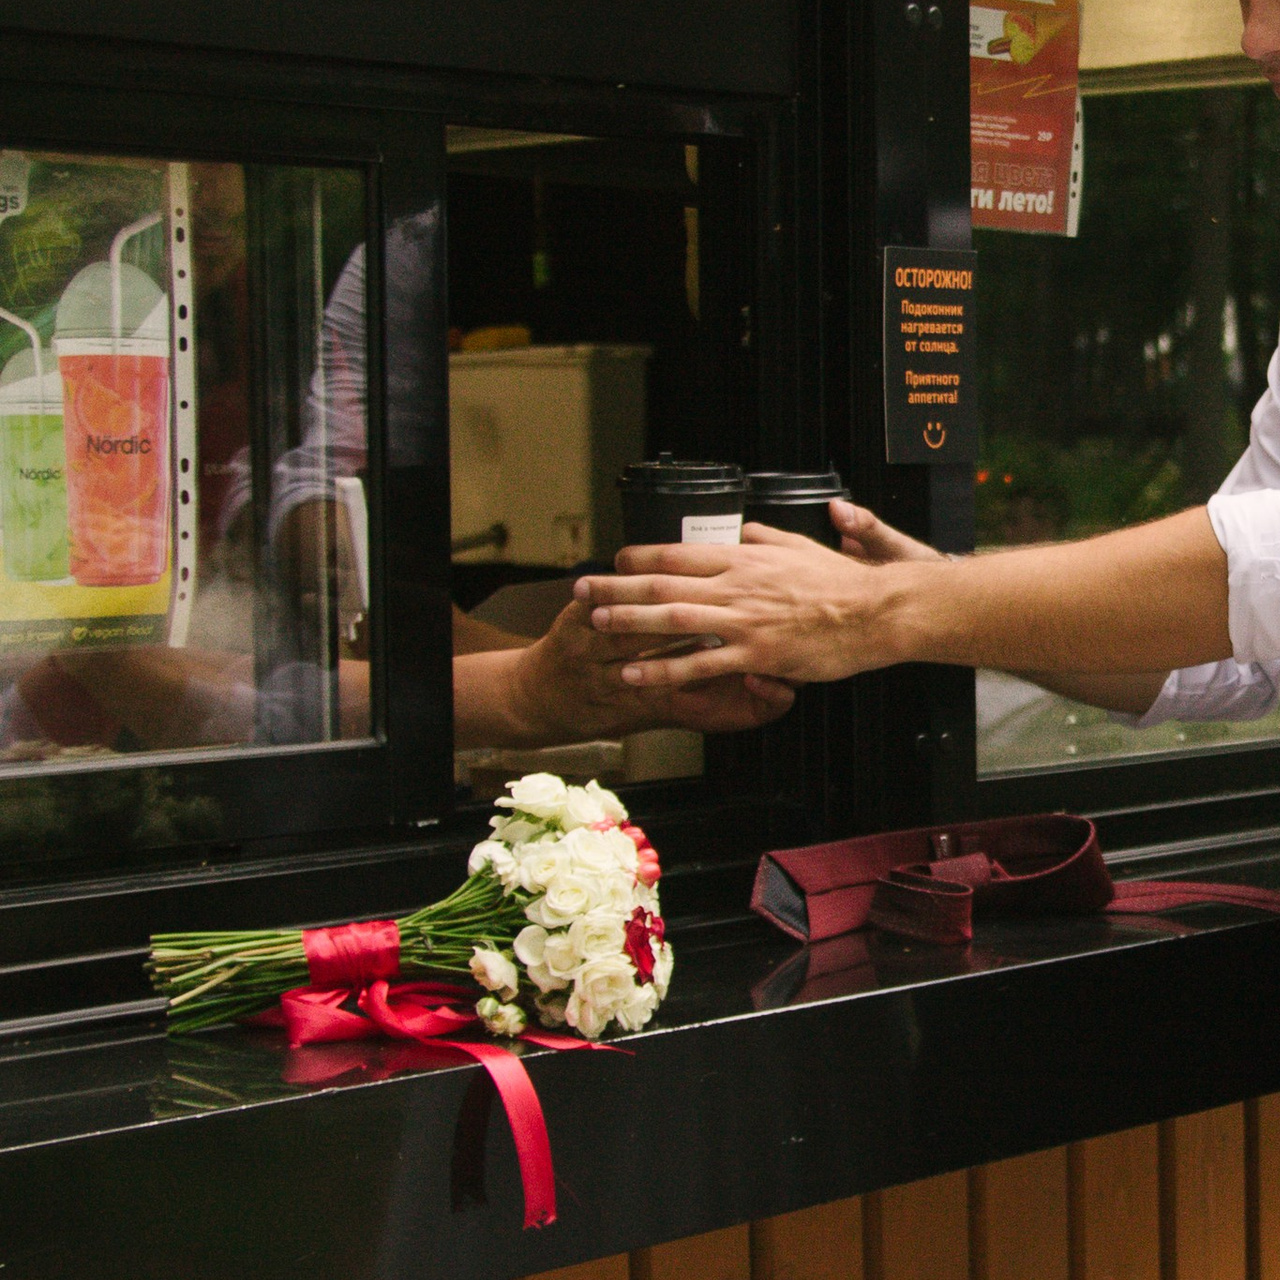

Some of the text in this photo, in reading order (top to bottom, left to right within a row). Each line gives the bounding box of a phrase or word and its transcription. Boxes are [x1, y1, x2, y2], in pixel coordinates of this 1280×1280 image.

[998, 190, 1055, 215] лето!
[895, 267, 973, 291] ОСТОРОЖНО!
[901, 299, 964, 318] Подоконник
[901, 322, 964, 337] нагревается
[905, 341, 960, 355] от солнца.
[905, 371, 960, 389] Приятного
[908, 390, 959, 405] аппетита!
[86, 435, 152, 455] Nördic
